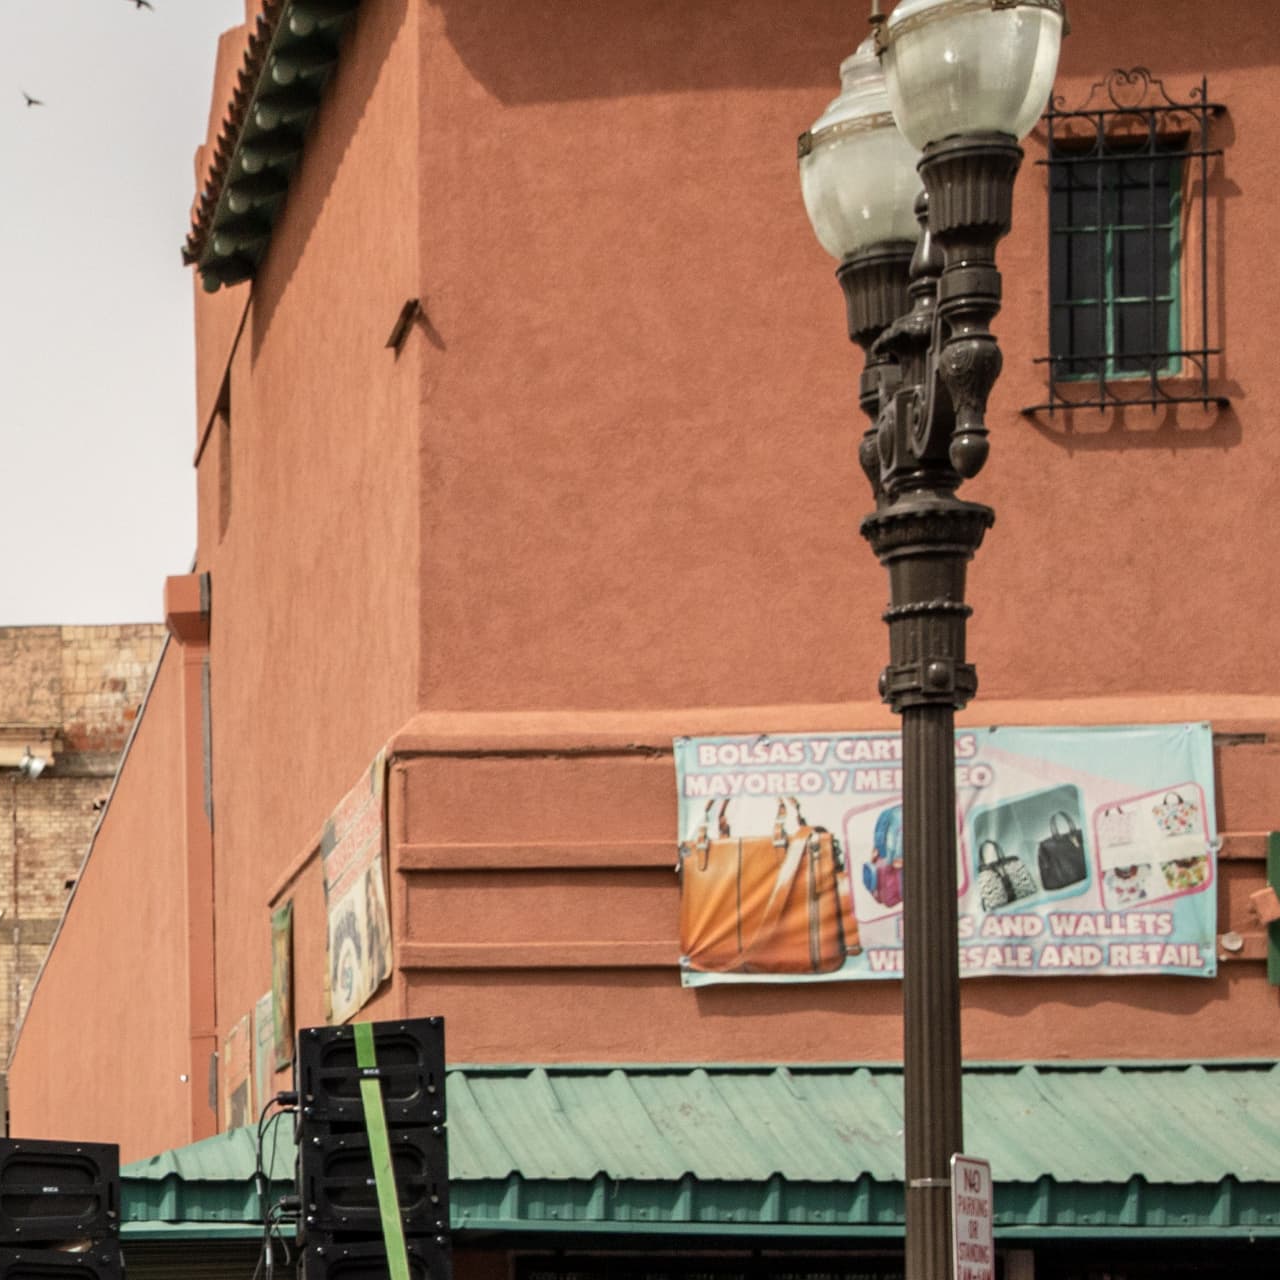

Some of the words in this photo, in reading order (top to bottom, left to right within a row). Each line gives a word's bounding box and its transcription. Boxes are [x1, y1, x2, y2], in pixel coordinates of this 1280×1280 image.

[699, 742, 804, 767] BOLSAS
[810, 740, 828, 762] Y
[684, 771, 824, 798] MAYOREO
[830, 769, 849, 792] Y
[981, 914, 1042, 938] AND
[1049, 911, 1174, 938] WALLETS
[1039, 943, 1105, 969] AND
[1109, 943, 1204, 969] RETAIL
